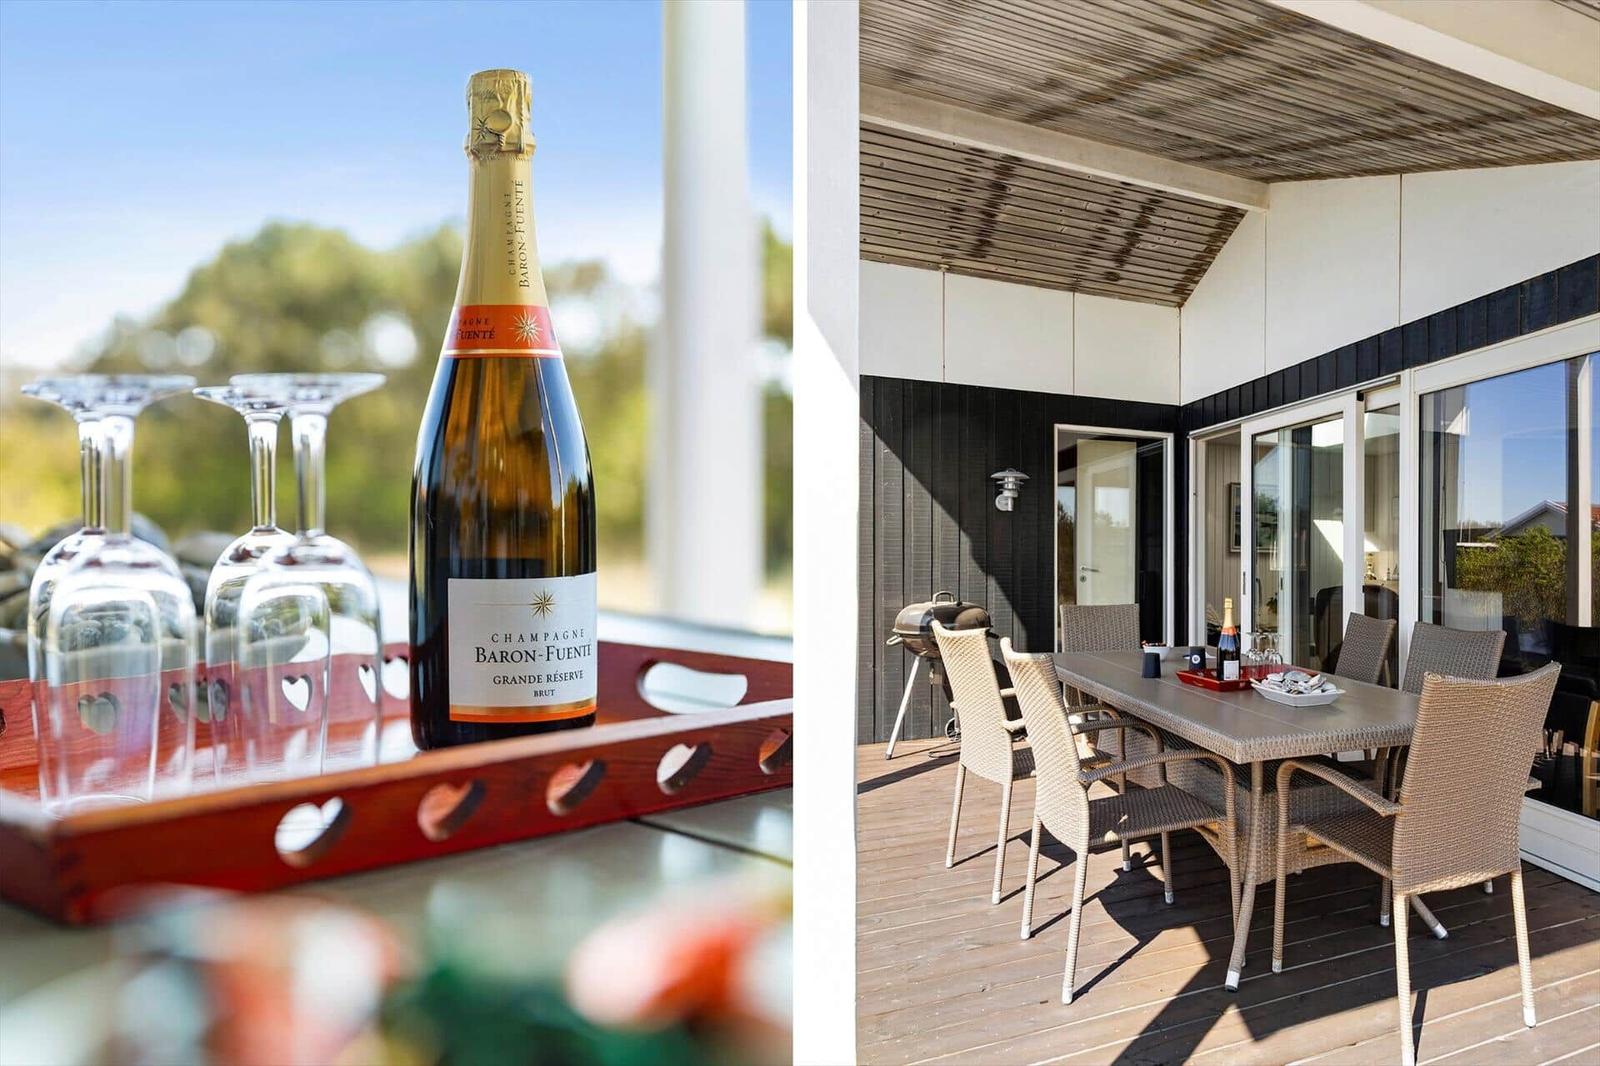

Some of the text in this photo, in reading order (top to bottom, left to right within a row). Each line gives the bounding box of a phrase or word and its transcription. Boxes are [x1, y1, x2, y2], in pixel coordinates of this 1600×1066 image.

[504, 193, 516, 276] CHAMPAGNE
[491, 628, 585, 643] CHAMPAGNE
[493, 669, 584, 685] GRANDE RÉSERVE
[533, 689, 555, 698] BRUT
